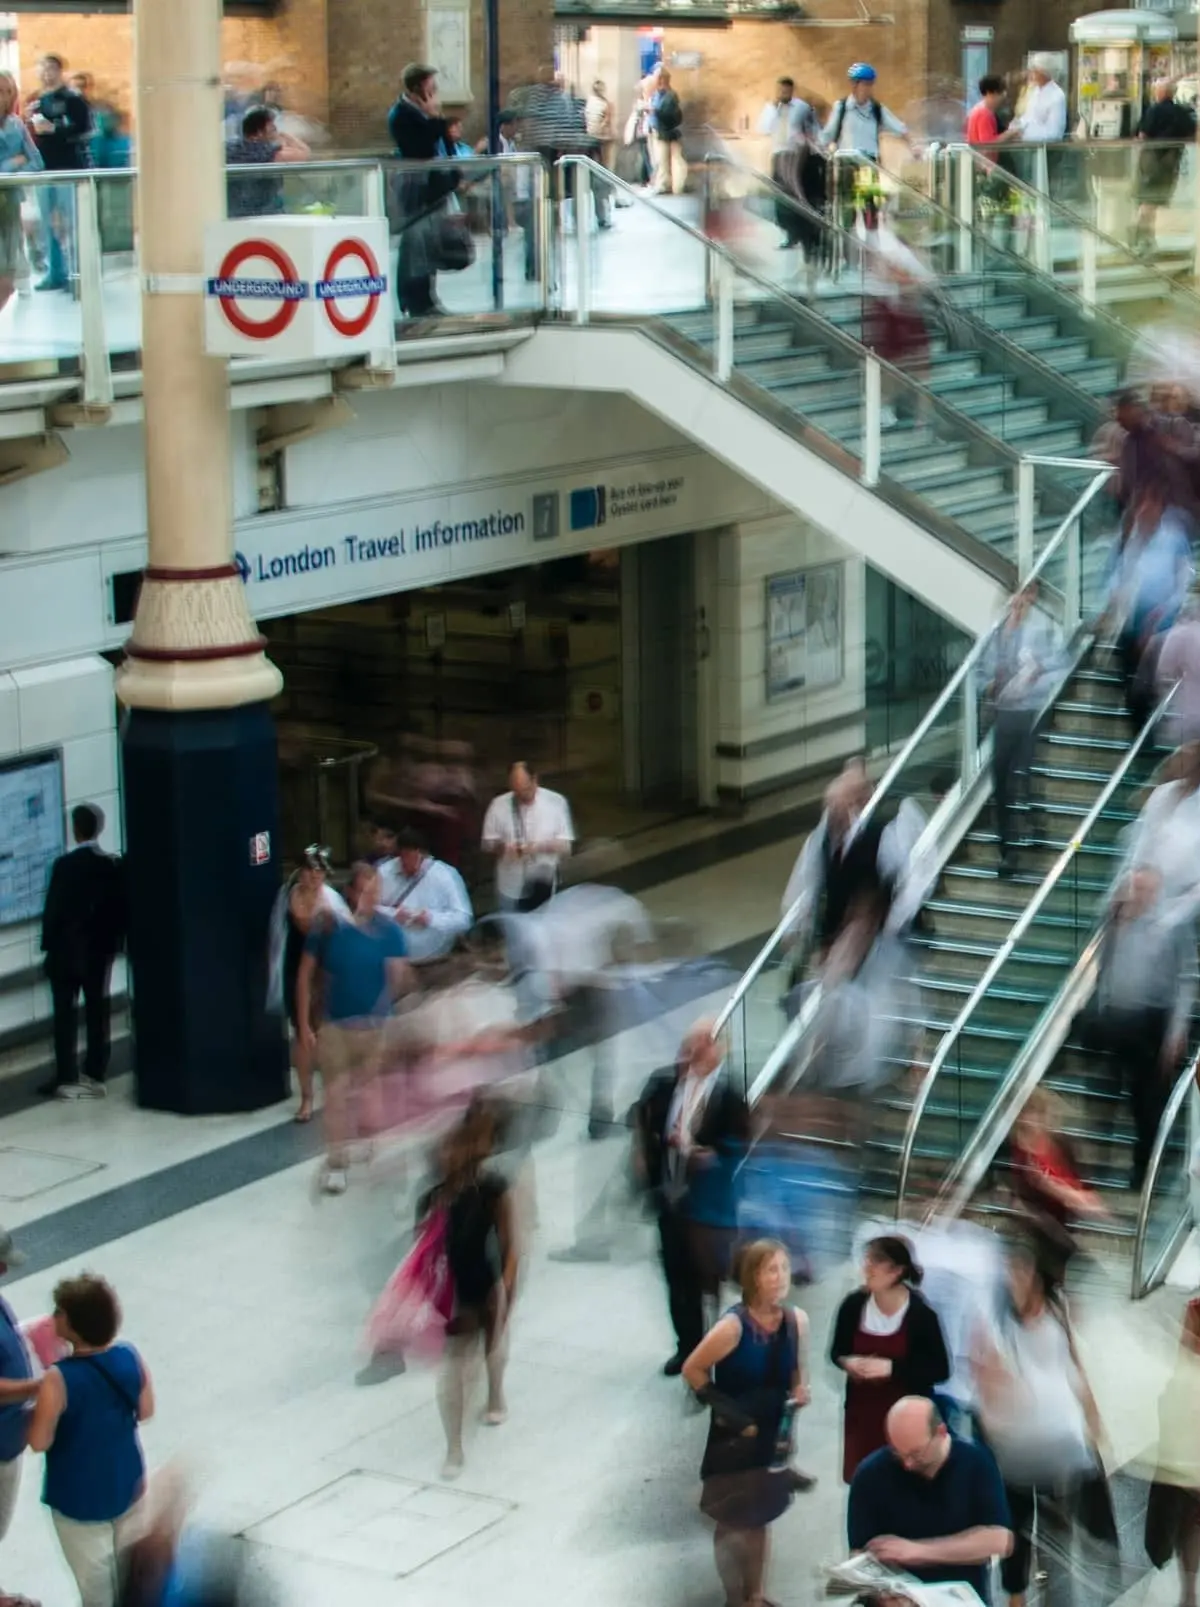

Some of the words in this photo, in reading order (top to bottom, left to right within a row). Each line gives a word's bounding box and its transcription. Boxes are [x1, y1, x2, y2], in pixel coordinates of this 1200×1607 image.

[213, 279, 304, 295] UNDERGROUND
[319, 277, 384, 295] UNDERGROUND
[258, 544, 335, 581] London
[345, 530, 406, 563] Travel
[415, 510, 525, 551] Information
